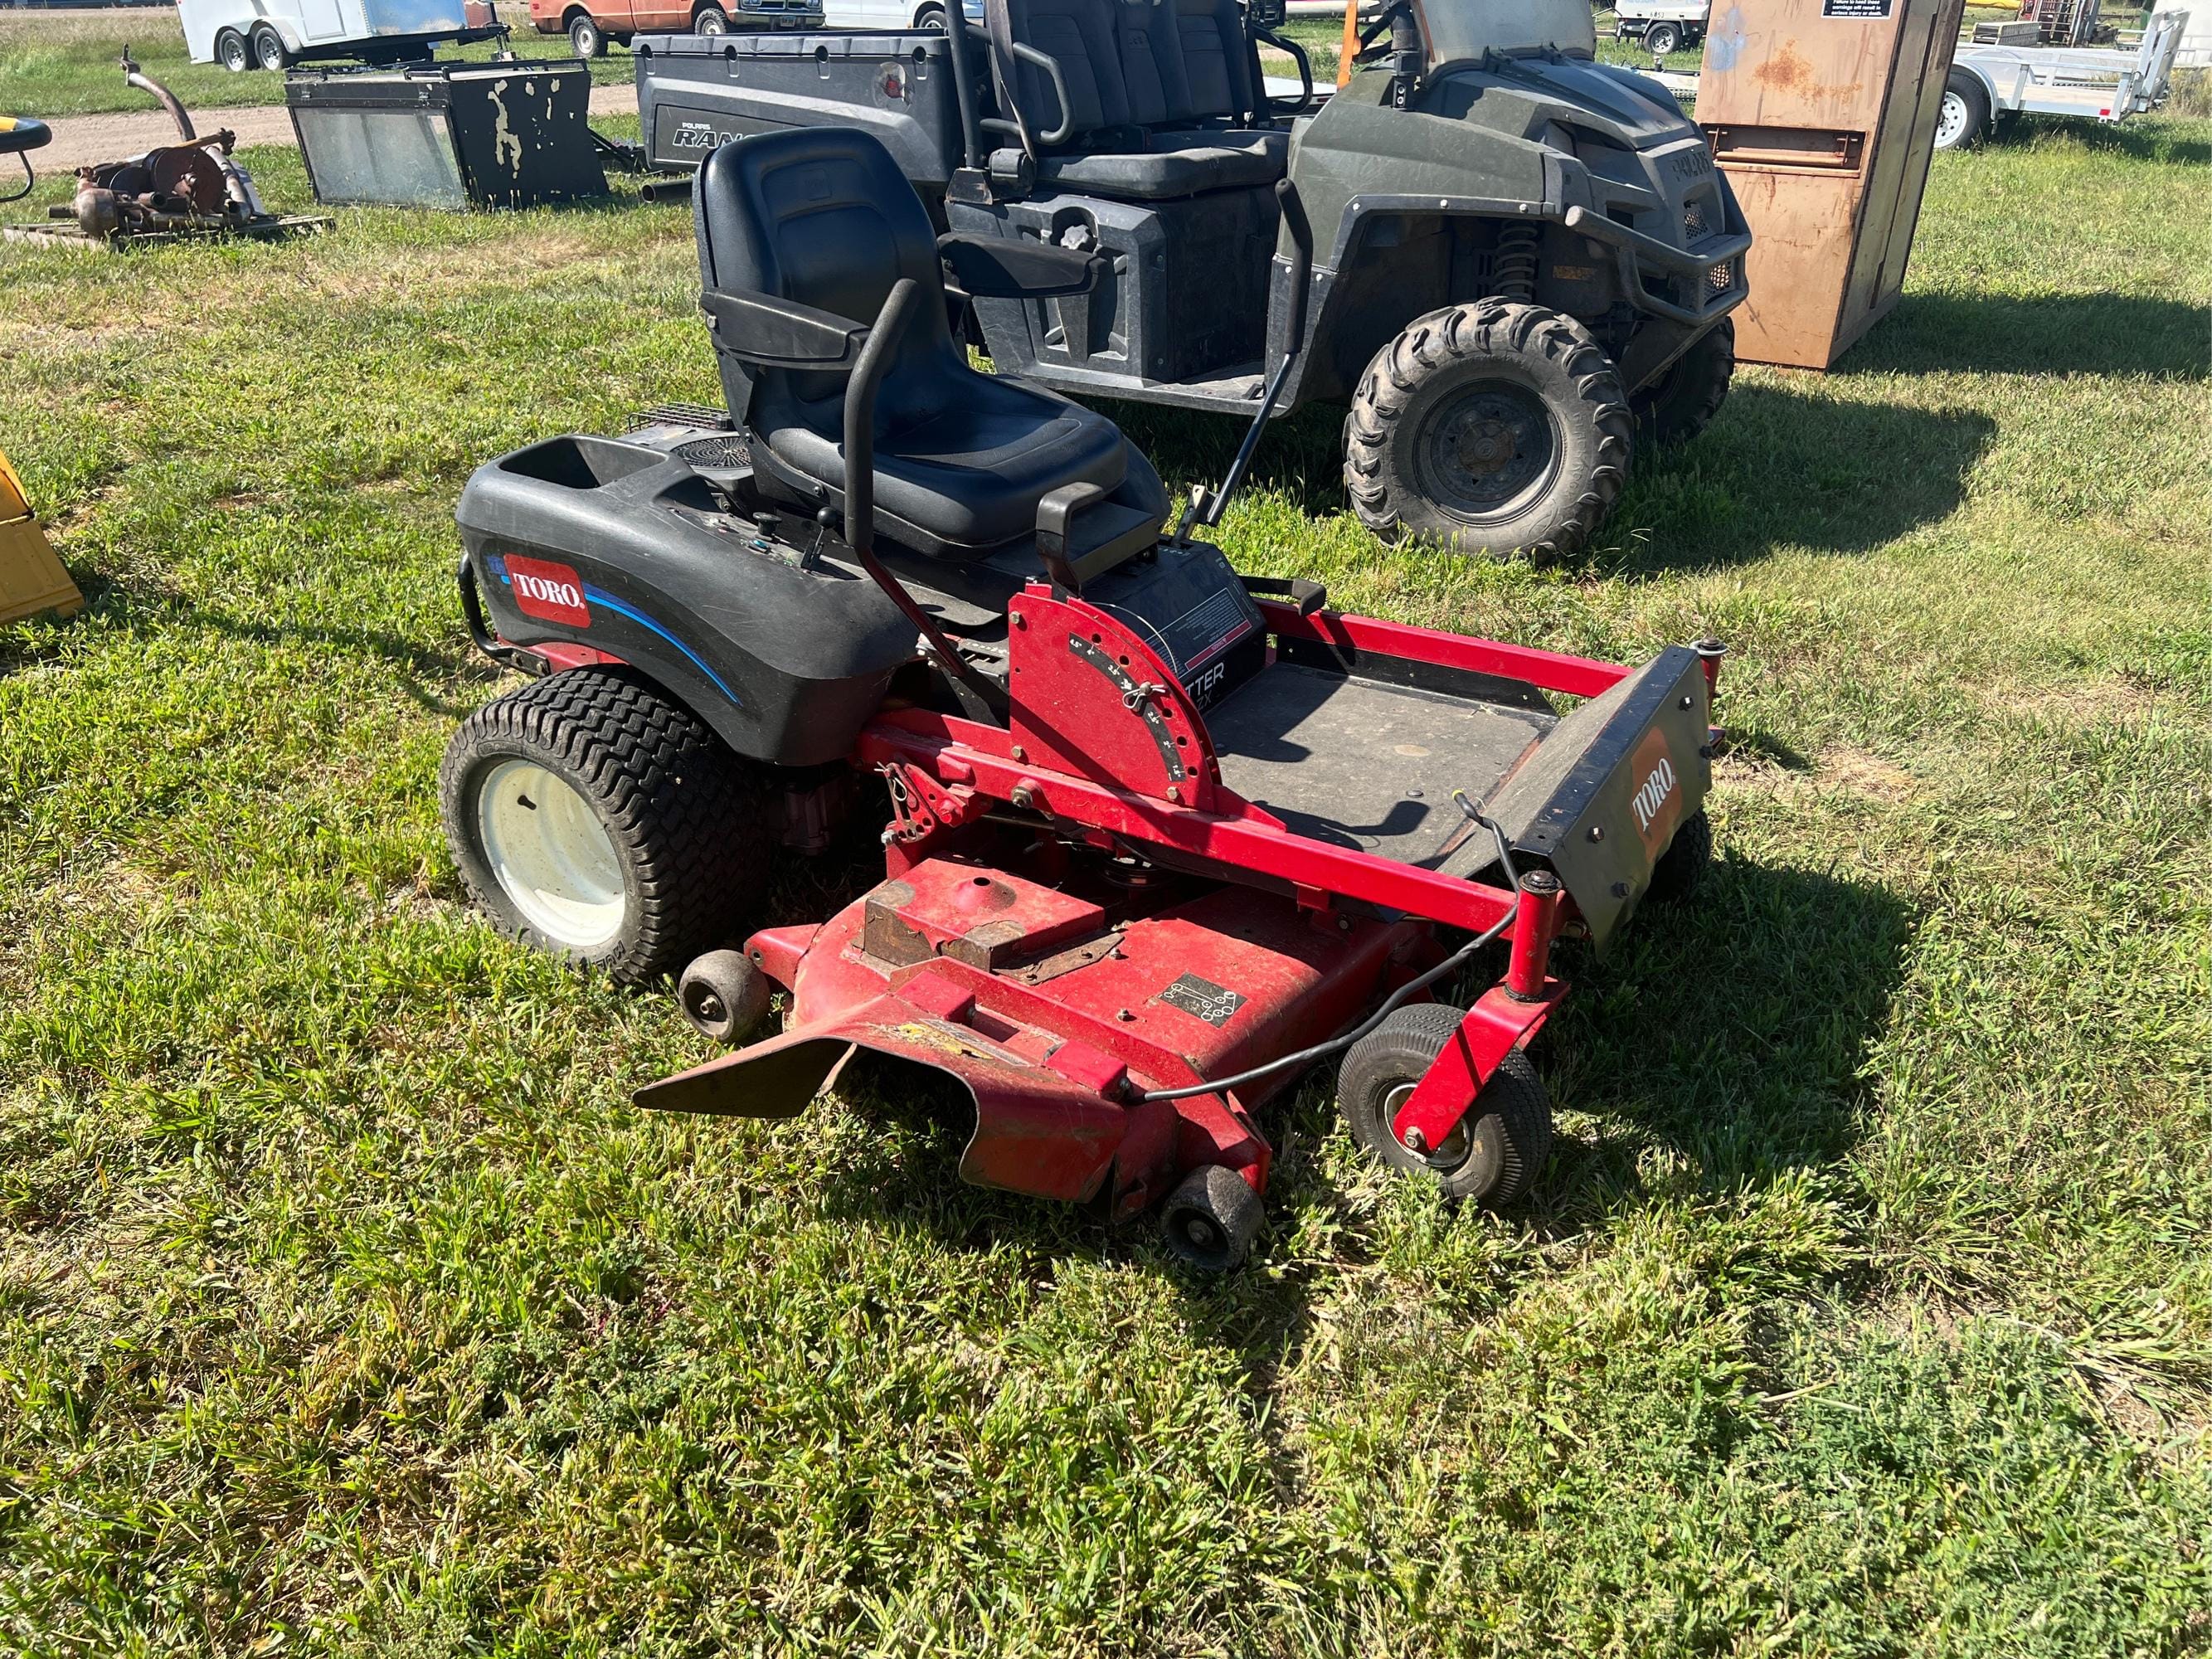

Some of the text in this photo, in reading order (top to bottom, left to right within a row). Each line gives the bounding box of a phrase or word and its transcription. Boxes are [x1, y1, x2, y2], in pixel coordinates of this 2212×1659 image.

[682, 122, 711, 130] POLARIS
[673, 129, 746, 148] RAN
[1185, 662, 1224, 697] TTER
